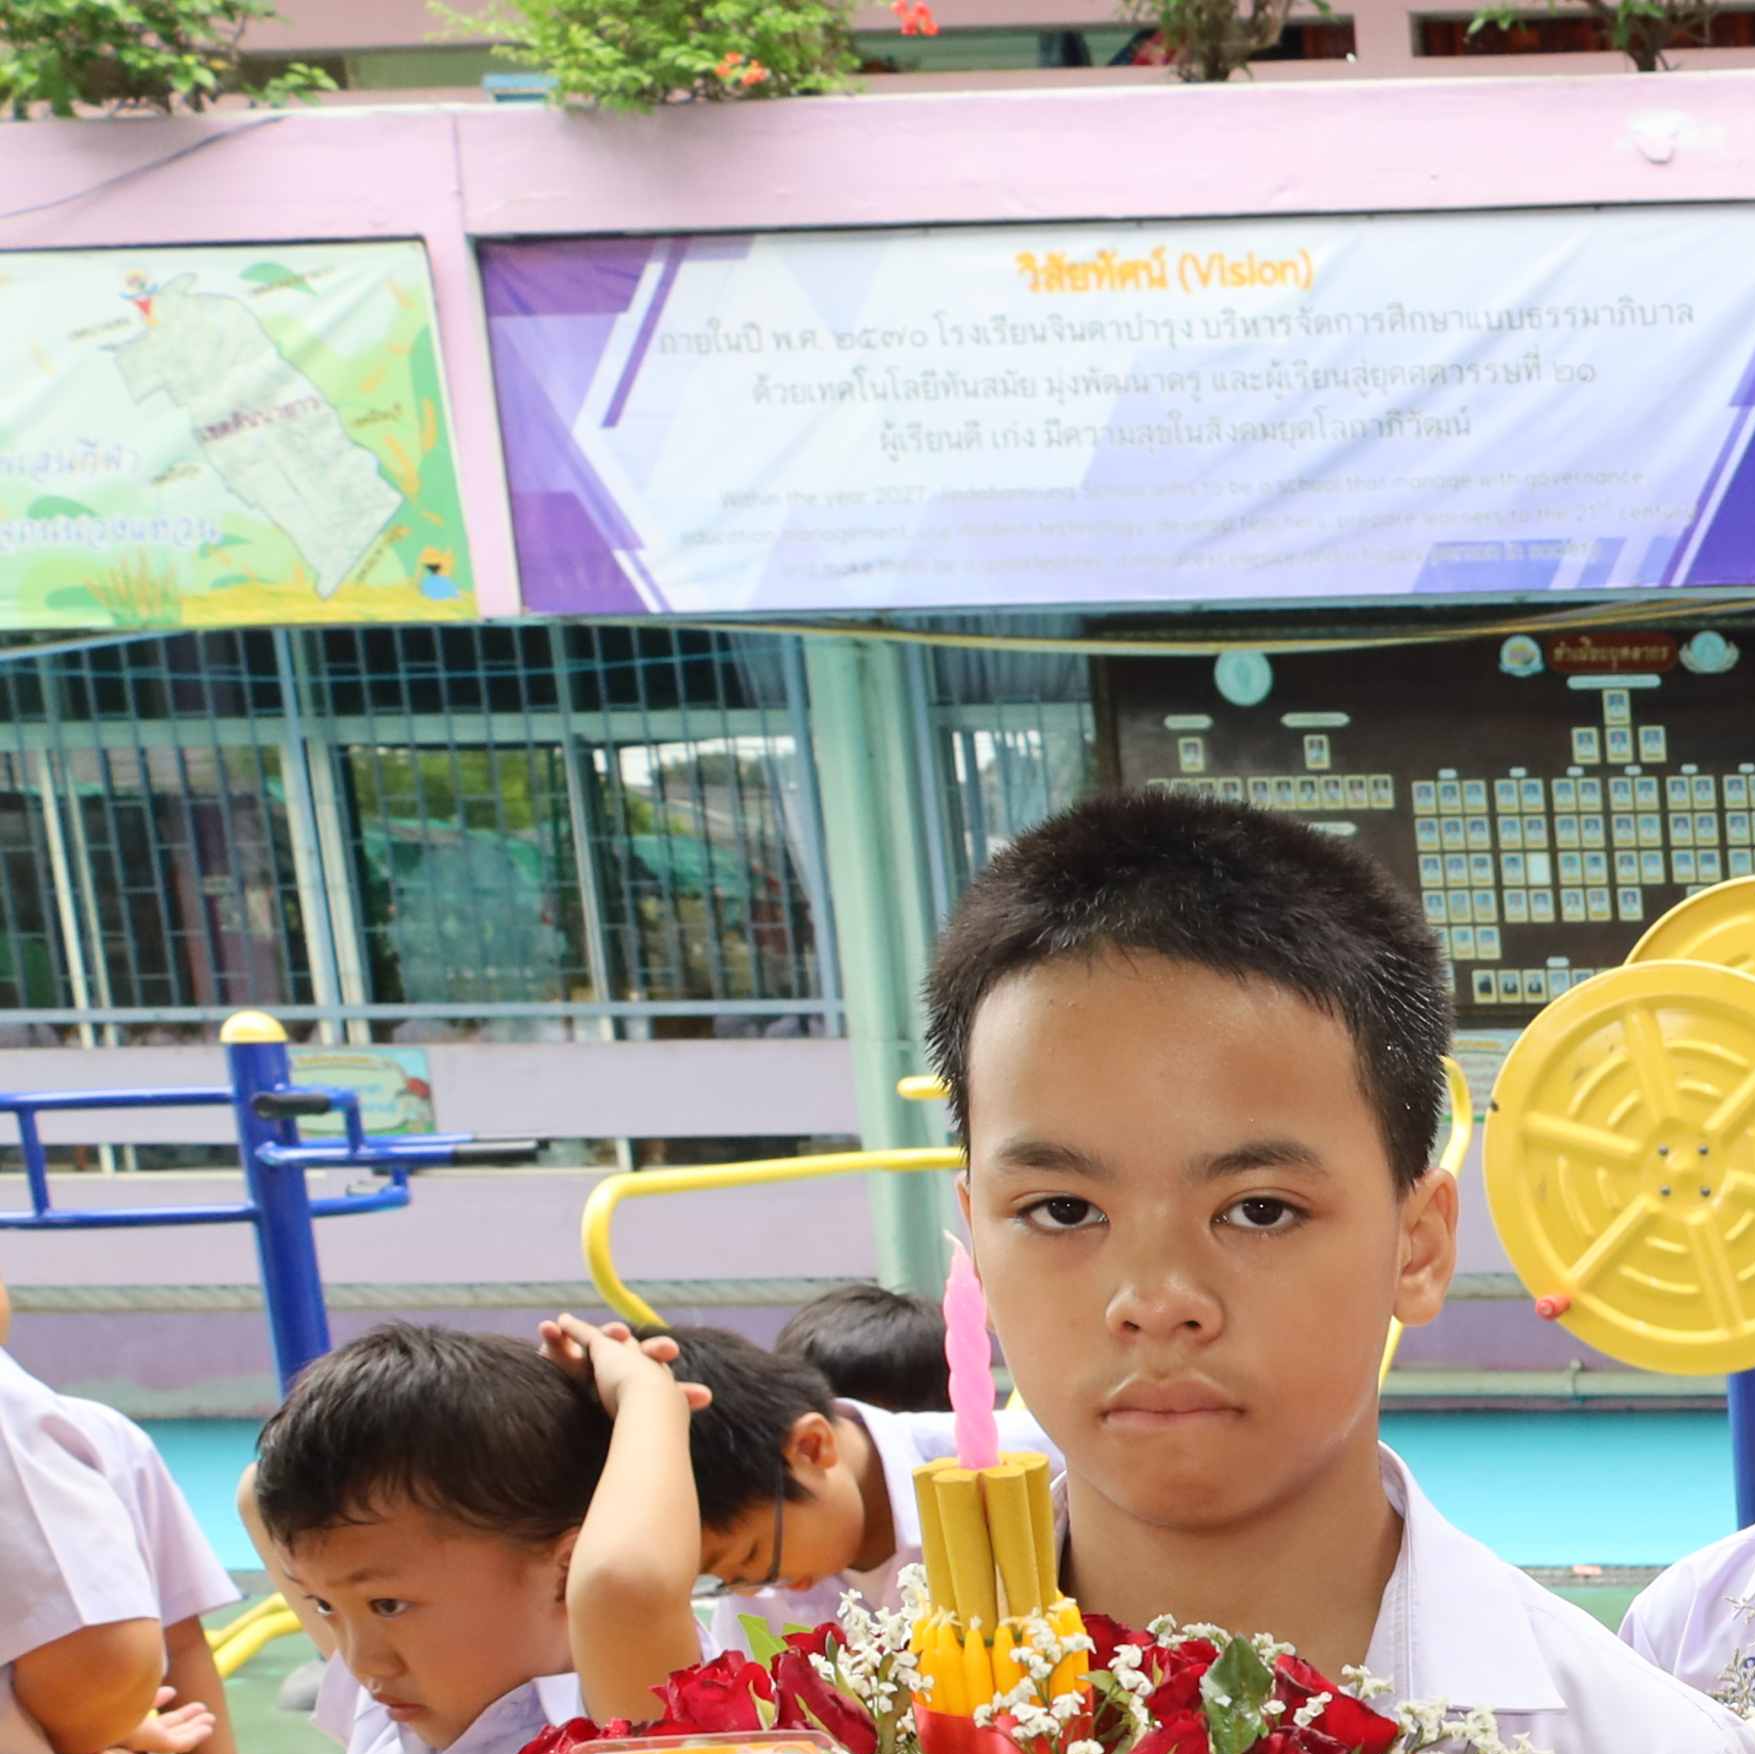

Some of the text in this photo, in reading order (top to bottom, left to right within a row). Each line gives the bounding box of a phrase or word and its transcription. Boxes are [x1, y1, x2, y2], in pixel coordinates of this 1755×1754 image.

[1015, 245, 1314, 295] วิสัยทัศน์ (Vision)
[657, 317, 763, 355] ภายในปี
